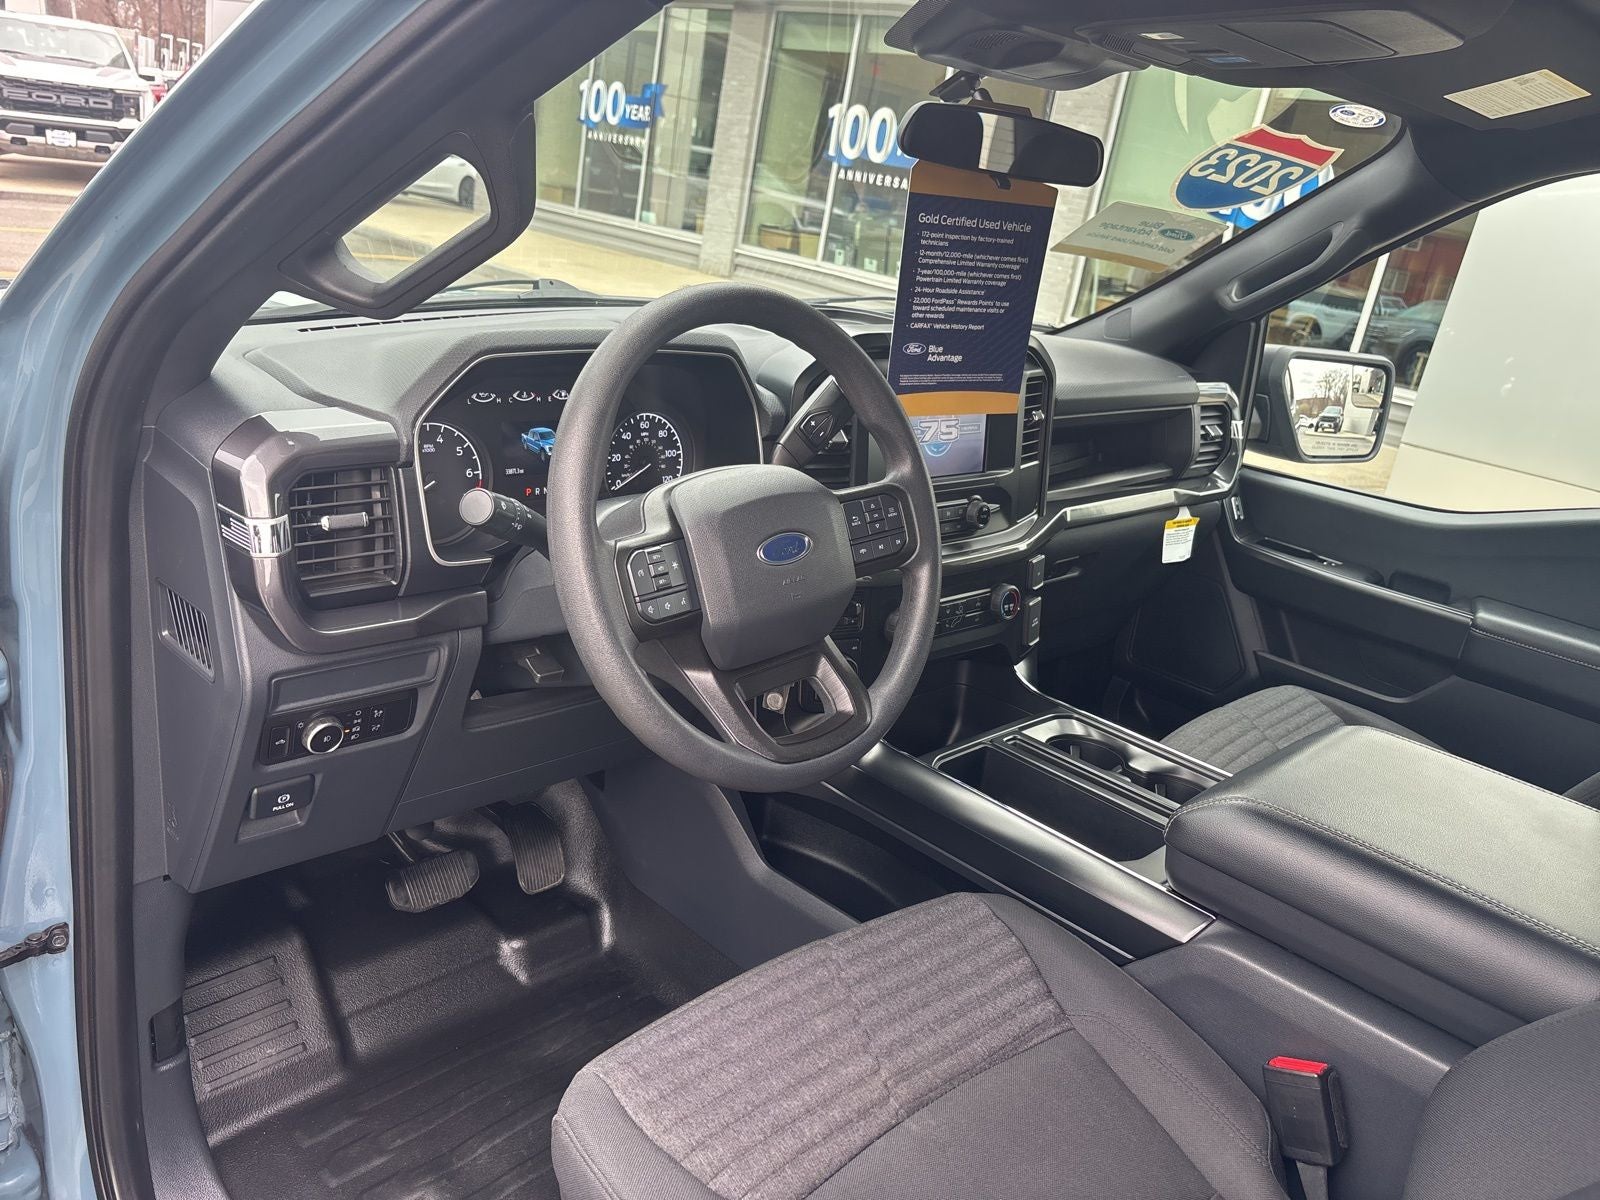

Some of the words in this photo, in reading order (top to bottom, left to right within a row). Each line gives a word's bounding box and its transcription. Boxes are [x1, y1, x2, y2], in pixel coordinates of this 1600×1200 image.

[2, 88, 114, 110] FORD
[579, 79, 626, 126] 100
[828, 103, 898, 164] 100
[838, 167, 909, 190] ANNIVERSA
[918, 212, 940, 224] Gold
[940, 215, 978, 228] Certified
[979, 218, 1001, 230] Used
[1002, 220, 1032, 233] Vehicle
[971, 235, 977, 243] by
[976, 261, 998, 269] Warranty
[928, 345, 944, 353] Blue
[927, 354, 963, 363] Advantage
[640, 421, 649, 429] 60
[658, 430, 668, 438] 80
[919, 418, 959, 443] 75
[436, 434, 444, 444] 4
[621, 432, 632, 440] 40
[456, 446, 463, 456] 5
[611, 453, 621, 462] 20
[466, 468, 473, 478] 6
